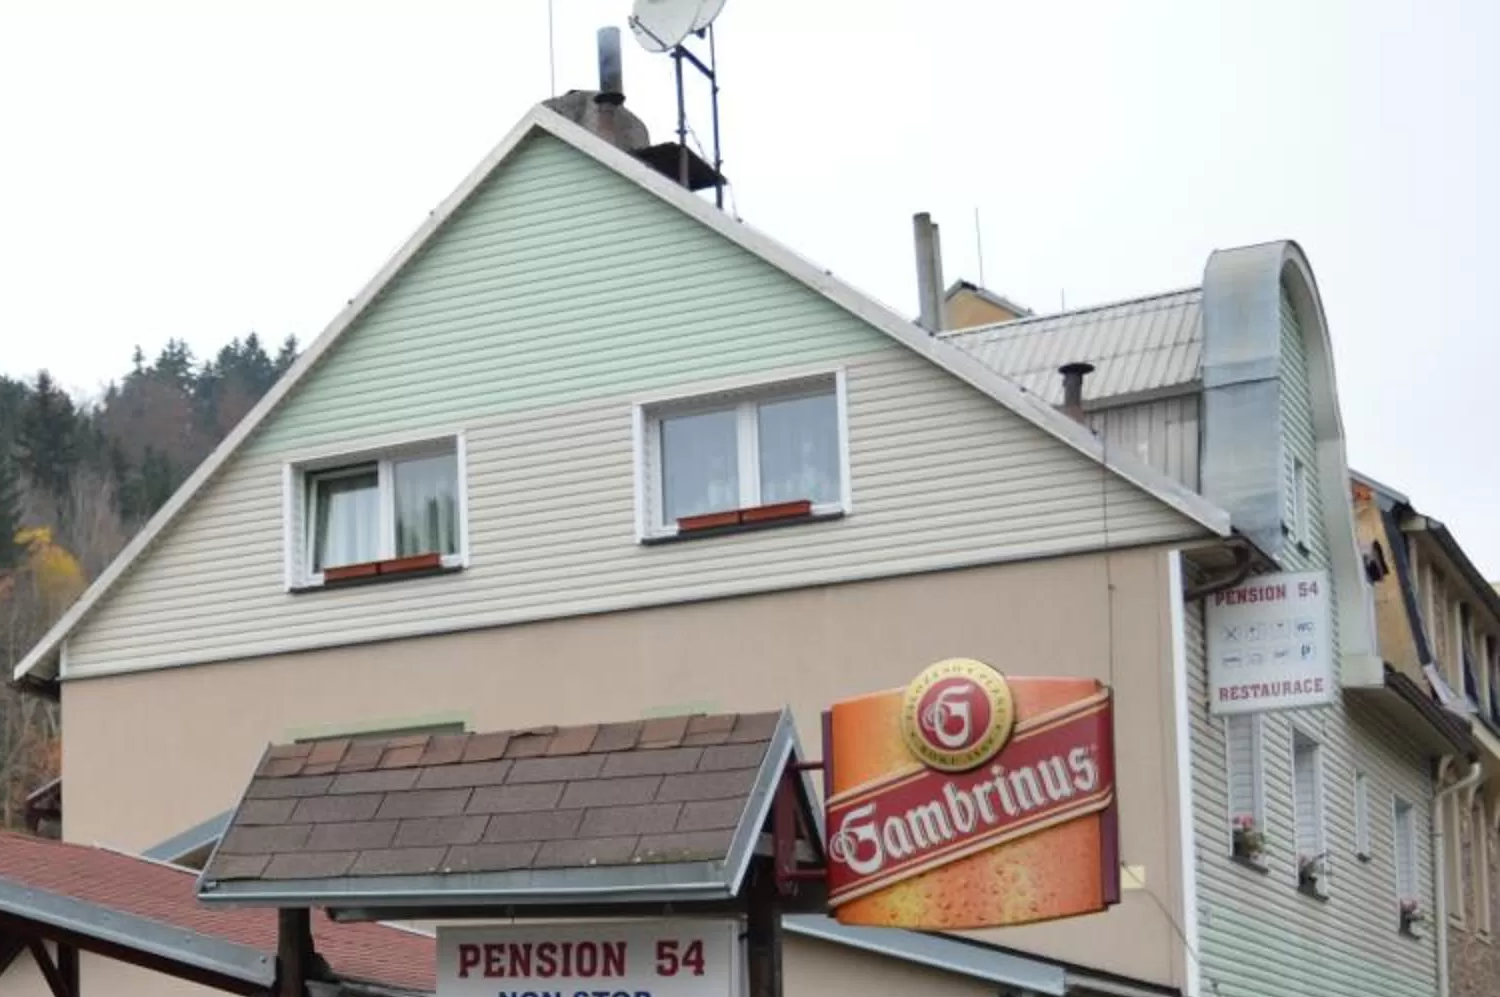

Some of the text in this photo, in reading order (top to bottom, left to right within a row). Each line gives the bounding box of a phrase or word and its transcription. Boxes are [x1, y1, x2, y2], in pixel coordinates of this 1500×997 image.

[1214, 580, 1319, 607] PENSION 54
[1218, 677, 1325, 702] RESTAURACE
[829, 744, 1100, 876] Gambrinus
[458, 939, 705, 979] PENSION 54
